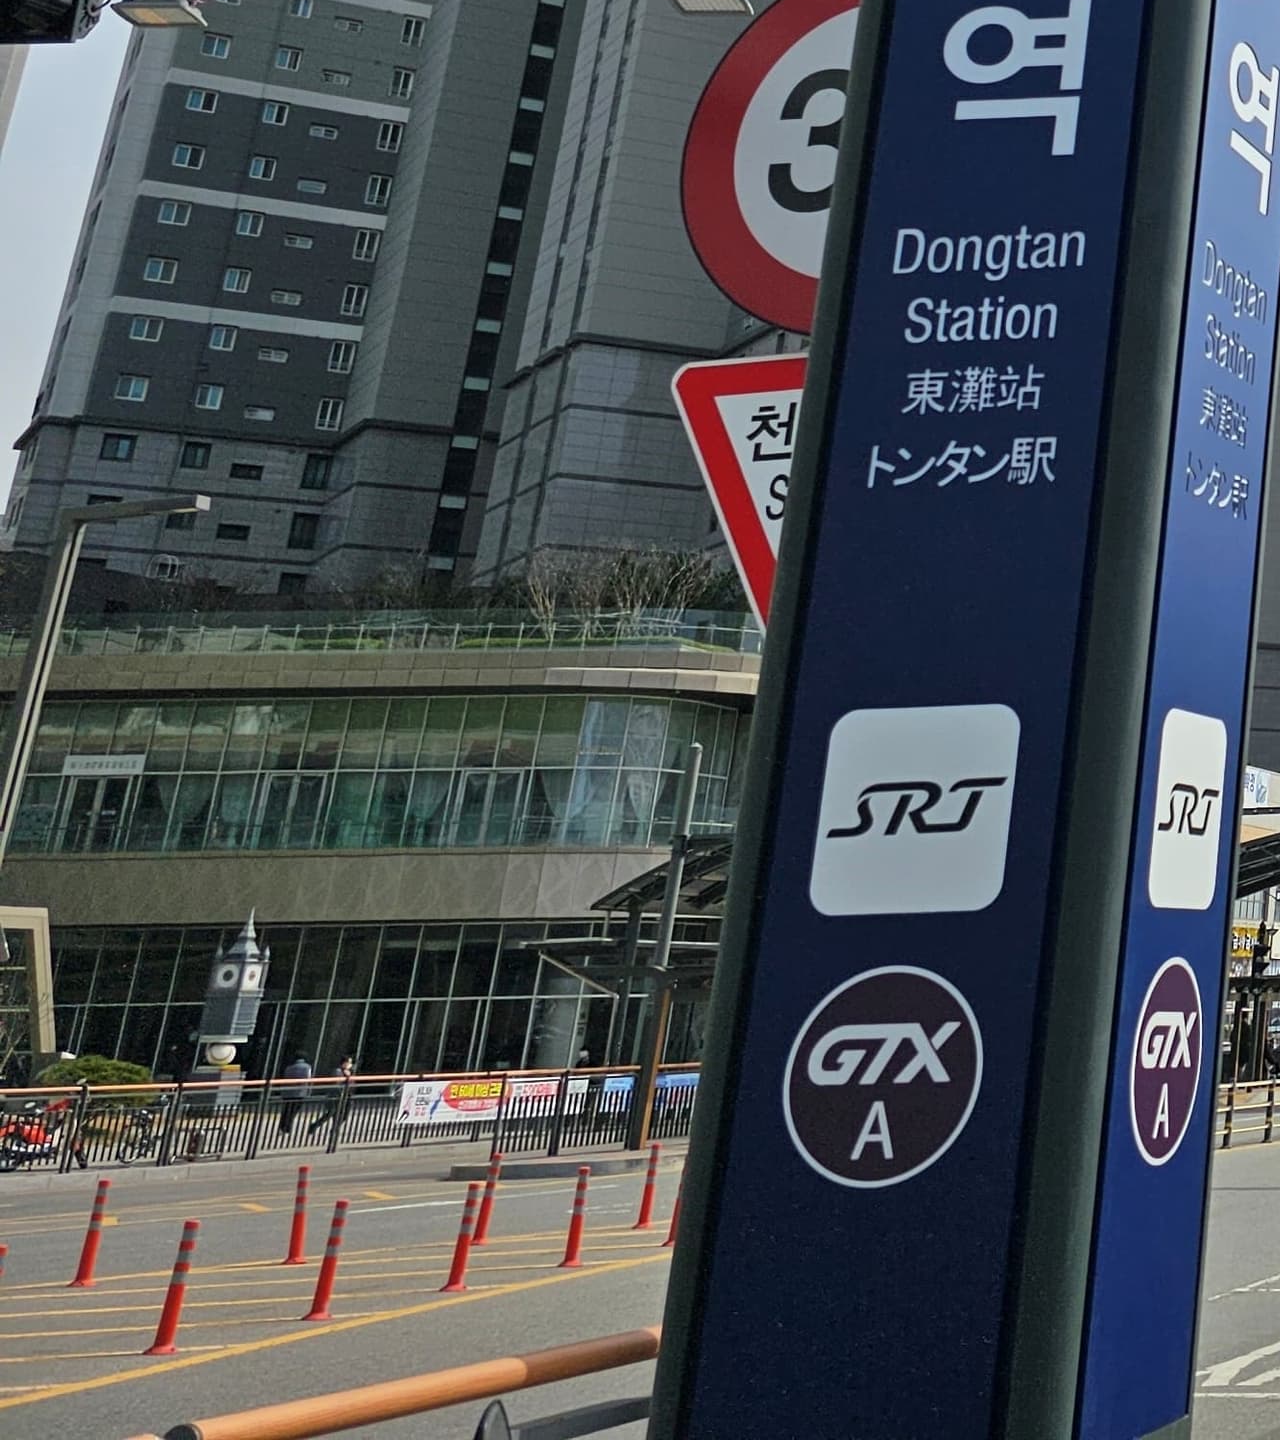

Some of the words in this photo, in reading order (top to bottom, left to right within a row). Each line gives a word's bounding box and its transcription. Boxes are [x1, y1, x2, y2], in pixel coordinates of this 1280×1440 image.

[892, 225, 1087, 281] Dongtan
[1202, 240, 1267, 326] Dongtan
[904, 295, 1058, 344] Station
[1205, 313, 1256, 386] Station
[901, 364, 1046, 415] 東灘站
[1200, 386, 1249, 449] 東灘站
[866, 436, 1058, 489] トンタン駅
[1186, 450, 1249, 521] トンタン駅
[826, 776, 1008, 839] SRT
[1158, 783, 1219, 836] SRT
[808, 1021, 961, 1086] GTX
[1142, 1010, 1197, 1070] GTX
[850, 1100, 894, 1162] A
[1152, 1082, 1169, 1139] A
